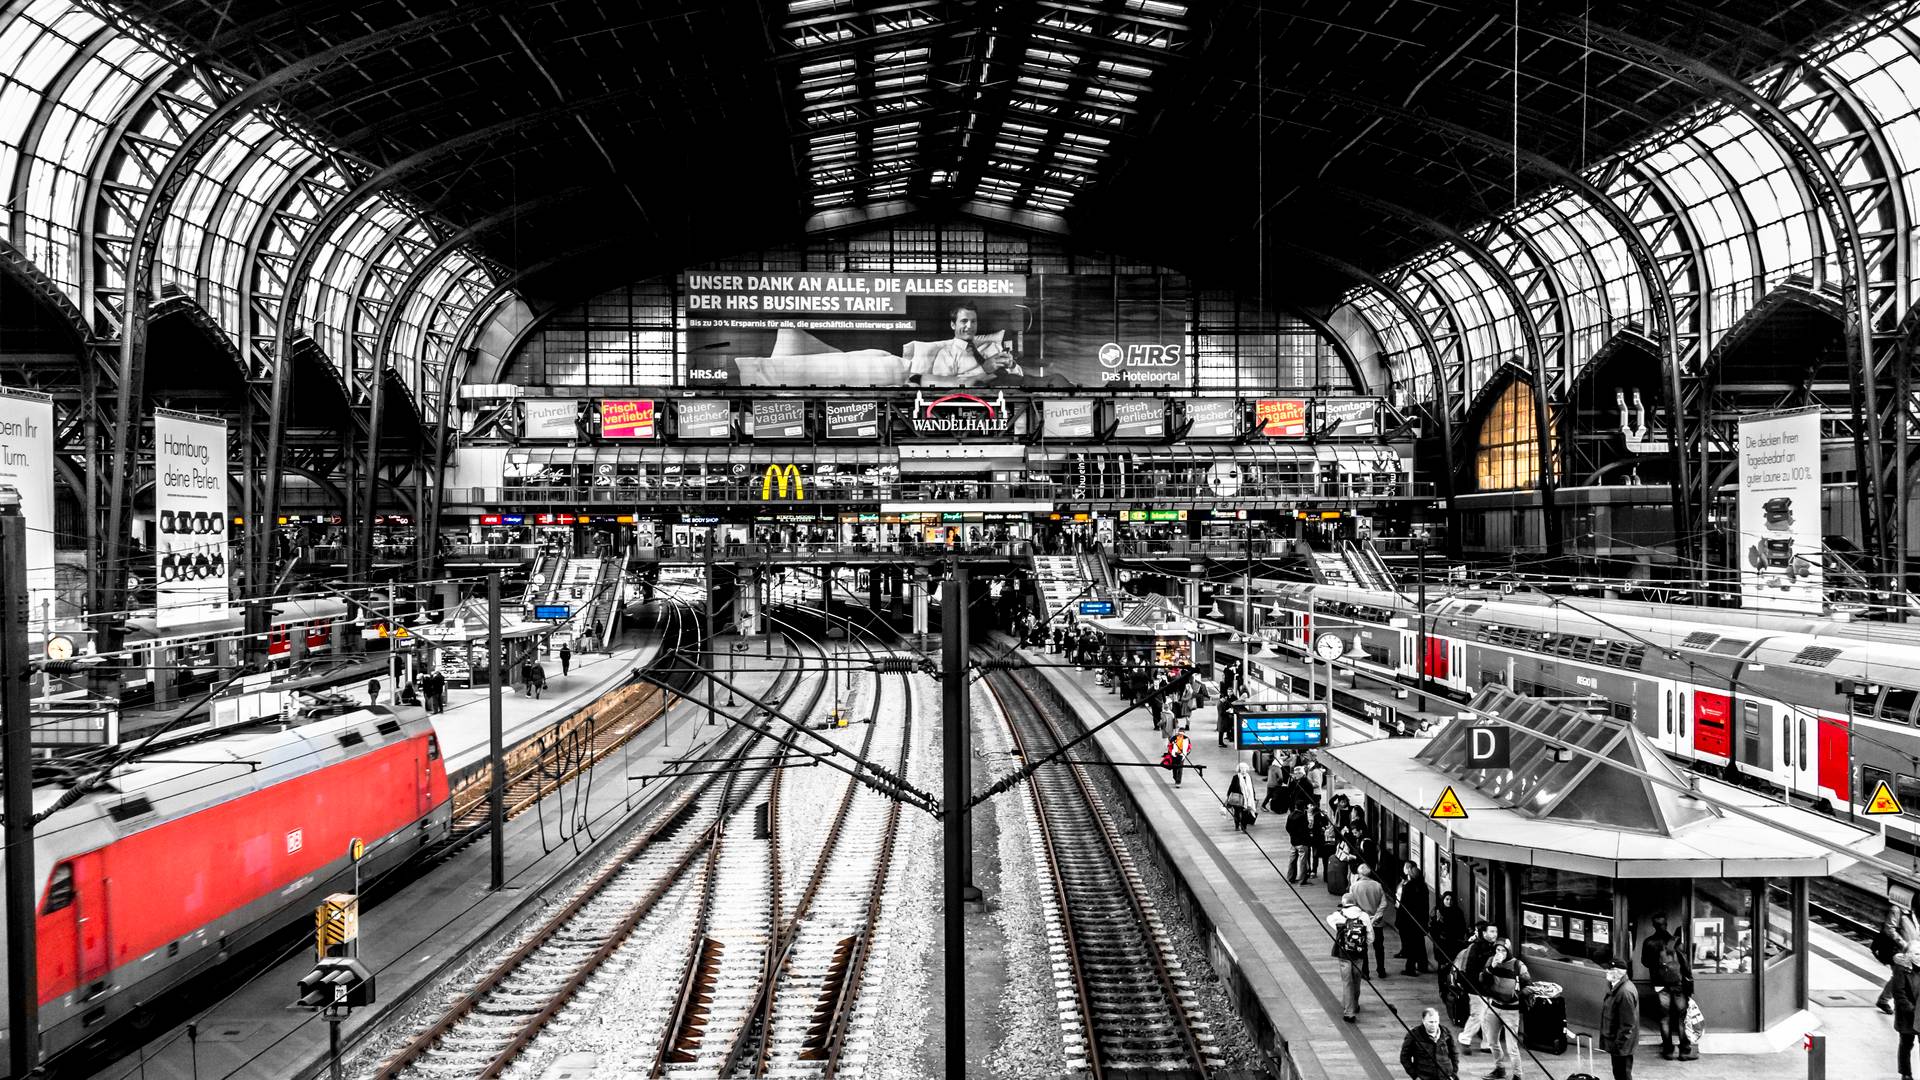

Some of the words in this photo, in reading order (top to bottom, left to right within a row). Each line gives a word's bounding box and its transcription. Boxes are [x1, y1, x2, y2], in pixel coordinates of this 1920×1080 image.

[689, 275, 743, 290] UNSER
[747, 276, 794, 291] DANK
[798, 277, 821, 291] AN
[826, 277, 870, 294] ALLE,
[874, 278, 900, 292] DIE
[904, 278, 953, 293] ALLES
[957, 278, 1014, 294] GEBEN:
[689, 295, 722, 309] DER
[726, 295, 758, 310] HRS
[763, 296, 840, 311] BUSINESS
[844, 296, 894, 312] TARIF.
[689, 319, 701, 327] Bis
[703, 319, 712, 327] zu
[731, 319, 766, 328] Ersparnis
[767, 320, 778, 328] für
[780, 320, 796, 329] alle,
[797, 320, 809, 328] die
[810, 320, 854, 329] geschäftlich
[855, 321, 894, 330] unterwegs
[895, 321, 913, 329] sind.
[1126, 344, 1181, 366] HRS
[689, 369, 728, 379] HRS.de
[1101, 371, 1120, 381] Das
[1123, 371, 1180, 382] Hotelportal
[603, 402, 637, 414] Frisch
[679, 402, 716, 414] Dauer-
[754, 402, 796, 415] Esstra-
[827, 402, 876, 415] Sonntags-
[1116, 402, 1148, 414] Frisch
[1186, 402, 1221, 414] Dauer-
[1257, 402, 1297, 414] Esstra-
[1326, 401, 1373, 414] Sonntags-
[604, 408, 653, 424] verliebt?
[680, 409, 729, 424] lutscher?
[755, 408, 803, 424] vagant?
[828, 411, 865, 424] fahrer?
[1117, 408, 1164, 424] verliebt?
[1257, 408, 1305, 424] vagant?
[1327, 410, 1362, 423] fahrer?
[25, 416, 38, 438] Ihr
[912, 419, 1008, 431] WANDELHALLE
[1745, 435, 1757, 449] Die
[1757, 432, 1781, 448] decken
[2, 445, 30, 466] Turm.
[164, 433, 209, 465] Hamburg,
[1746, 448, 1786, 469] Tagesbedarf
[164, 464, 190, 488] deine
[192, 467, 220, 490] Perlen.
[1782, 472, 1791, 482] zu
[1505, 583, 1512, 594] D
[1472, 728, 1496, 760] D
[1852, 765, 1859, 779] 2
